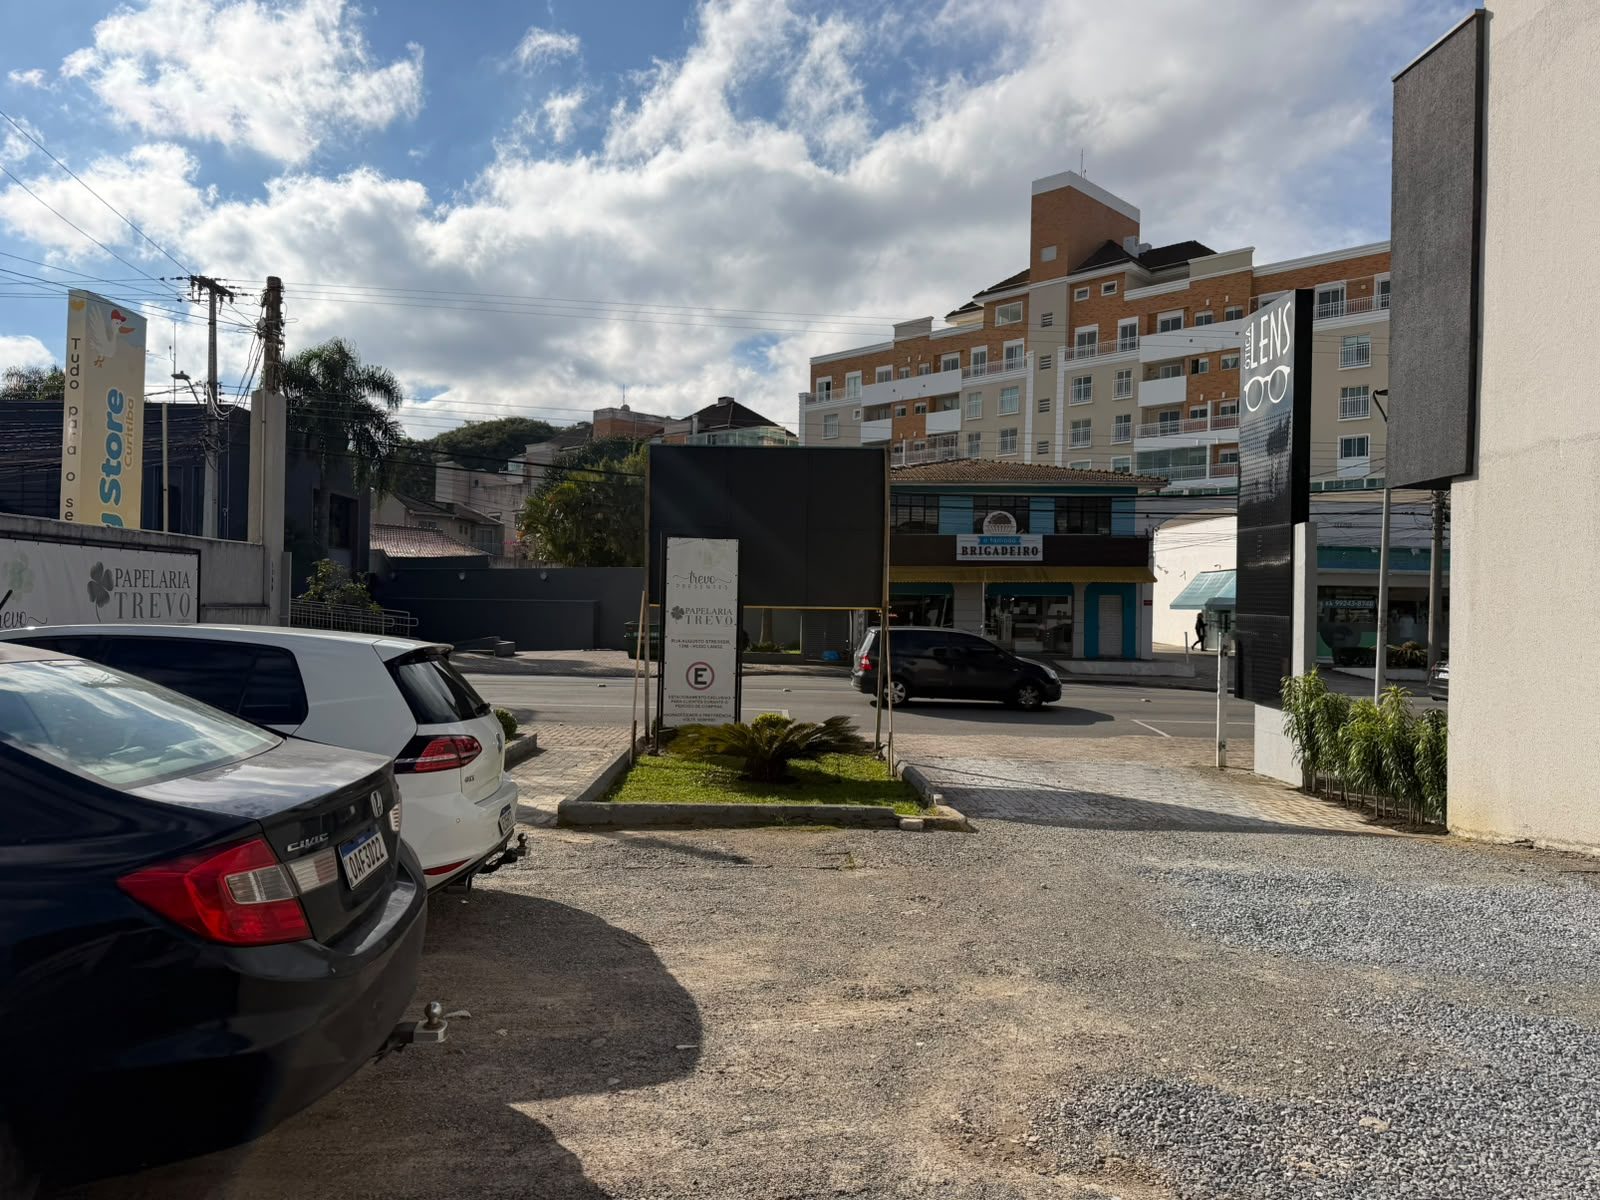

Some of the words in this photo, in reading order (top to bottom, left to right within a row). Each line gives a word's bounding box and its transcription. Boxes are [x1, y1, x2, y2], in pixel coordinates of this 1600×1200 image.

[1250, 301, 1291, 369] LENS
[69, 337, 81, 390] Tudo
[66, 405, 79, 456] paa
[124, 398, 135, 468] Curitiba
[99, 388, 124, 506] Store
[961, 546, 1039, 556] BRIGADEIRO
[115, 567, 191, 589] PAPELARIA
[688, 570, 716, 584] trevo
[114, 591, 191, 619] TREVO
[685, 607, 733, 615] PAPELARIA
[686, 615, 733, 625] TREVO
[694, 667, 707, 685] E
[287, 832, 329, 852] CIVIC
